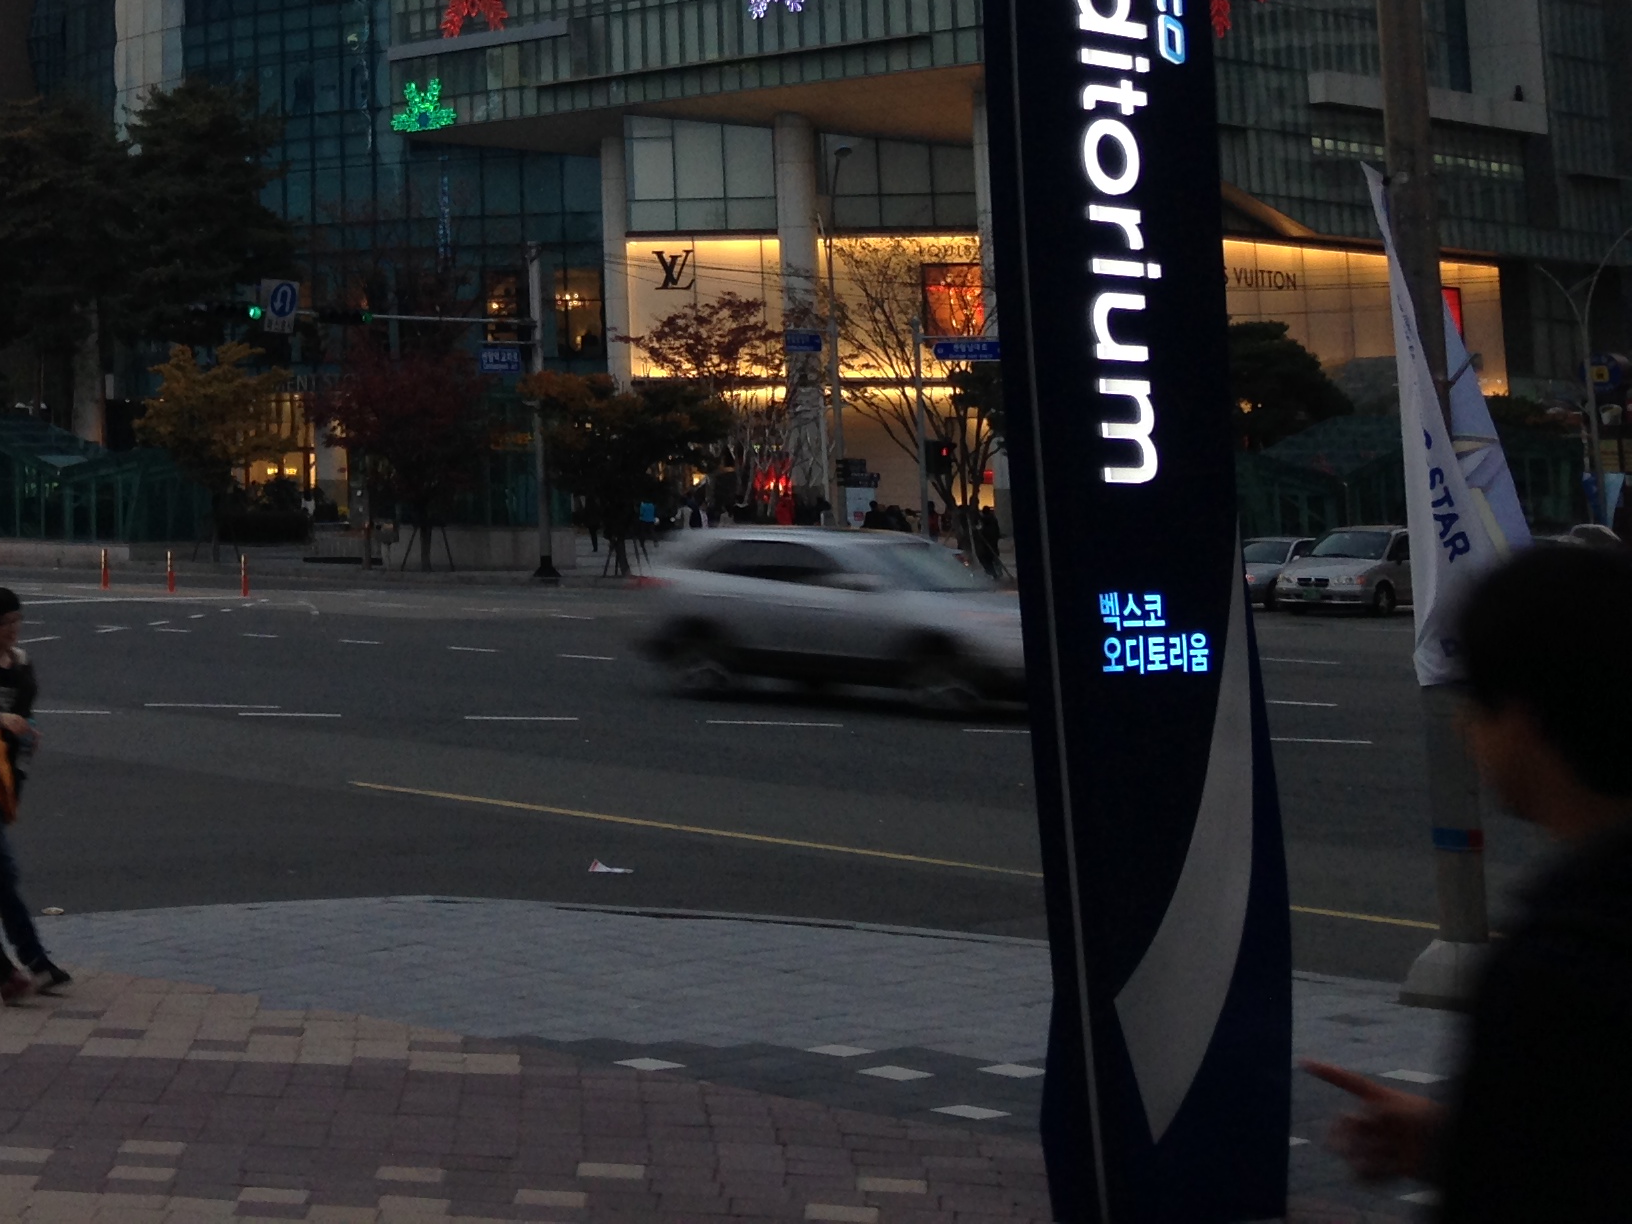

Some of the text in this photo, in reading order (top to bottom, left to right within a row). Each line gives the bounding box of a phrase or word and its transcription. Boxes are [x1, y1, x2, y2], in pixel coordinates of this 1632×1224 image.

[1233, 267, 1298, 291] VUITTON
[1099, 592, 1166, 631] 벡스코
[1103, 633, 1209, 674] 오디토리움
